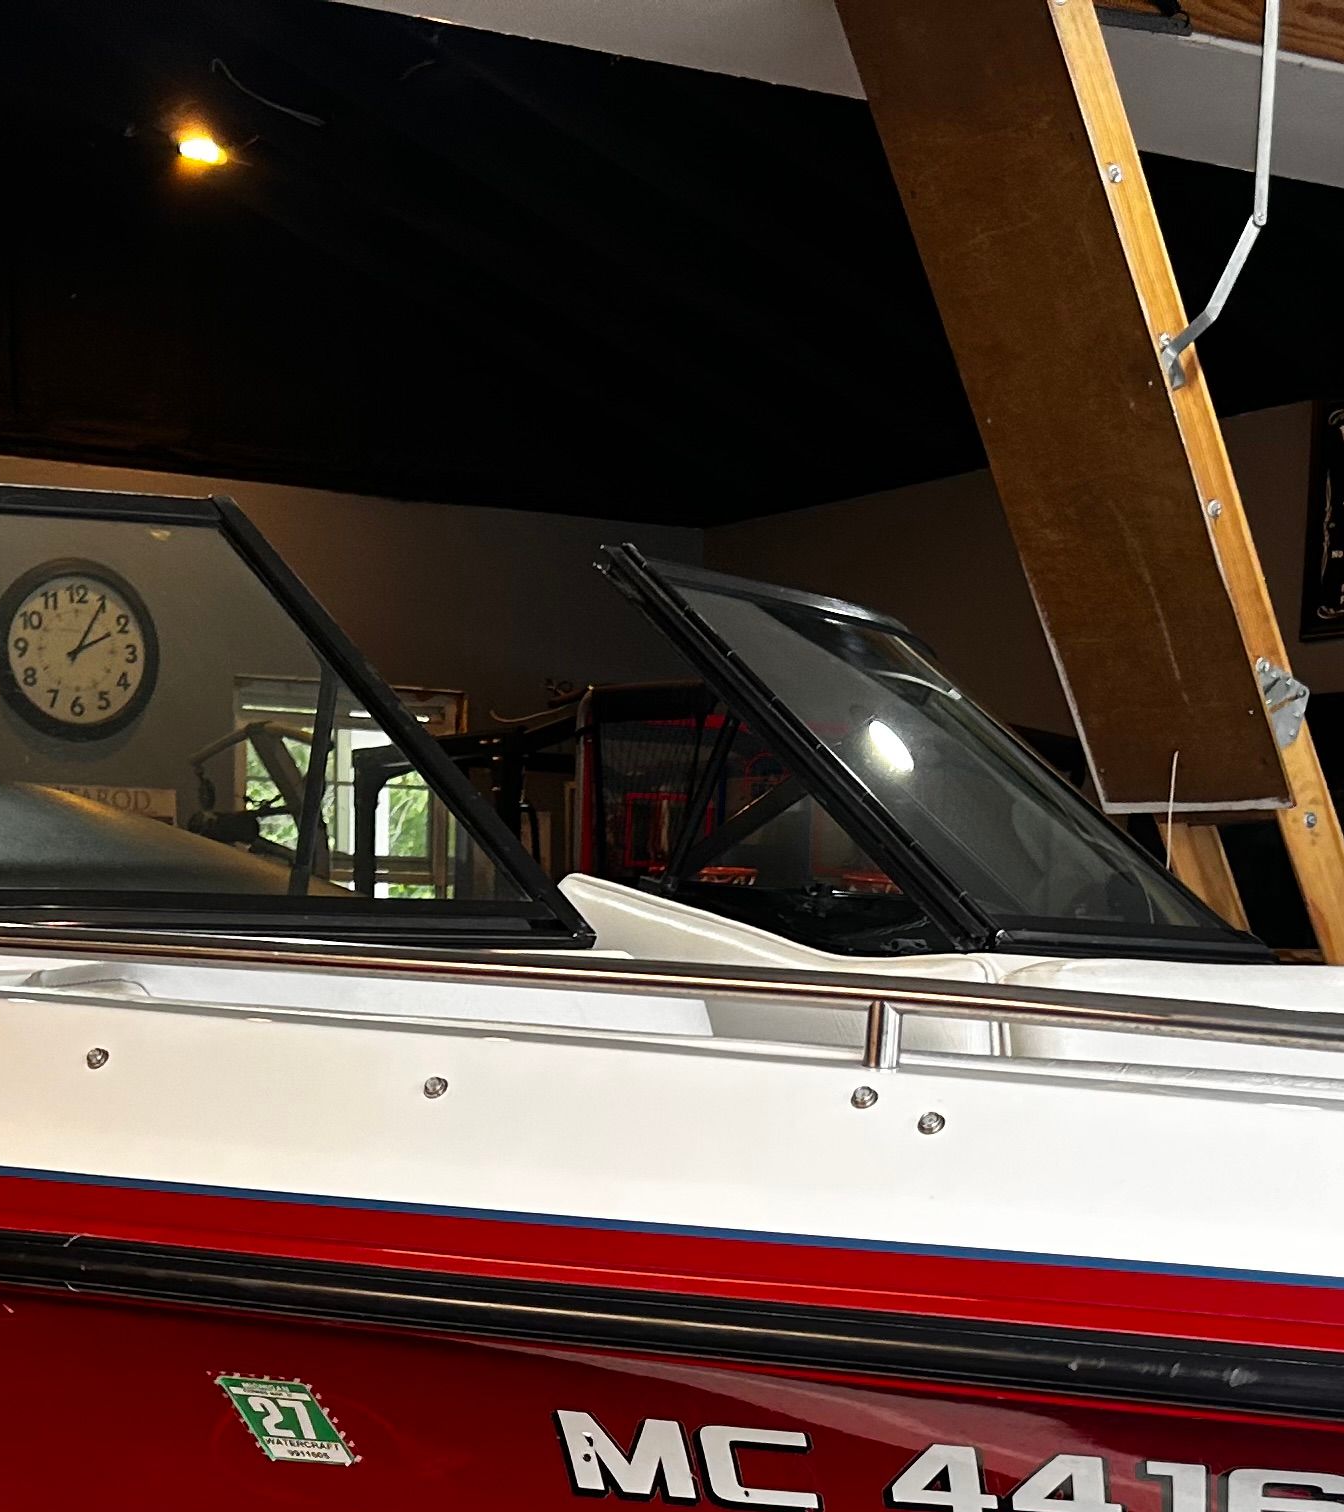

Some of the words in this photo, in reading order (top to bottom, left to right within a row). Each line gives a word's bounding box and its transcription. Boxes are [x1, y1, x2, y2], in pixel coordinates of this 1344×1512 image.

[41, 591, 58, 611] 11
[65, 584, 89, 604] 12
[20, 610, 43, 630] 10
[116, 614, 129, 634] 2
[13, 637, 28, 658] 9
[125, 644, 138, 664] 3
[23, 667, 37, 687] 8
[116, 671, 131, 691] 4
[46, 688, 59, 708] 7
[70, 696, 85, 717] 6
[97, 691, 111, 710] 5
[247, 1397, 317, 1440] 27
[264, 1438, 339, 1451] WATERCRAFT
[555, 1409, 821, 1511] MC
